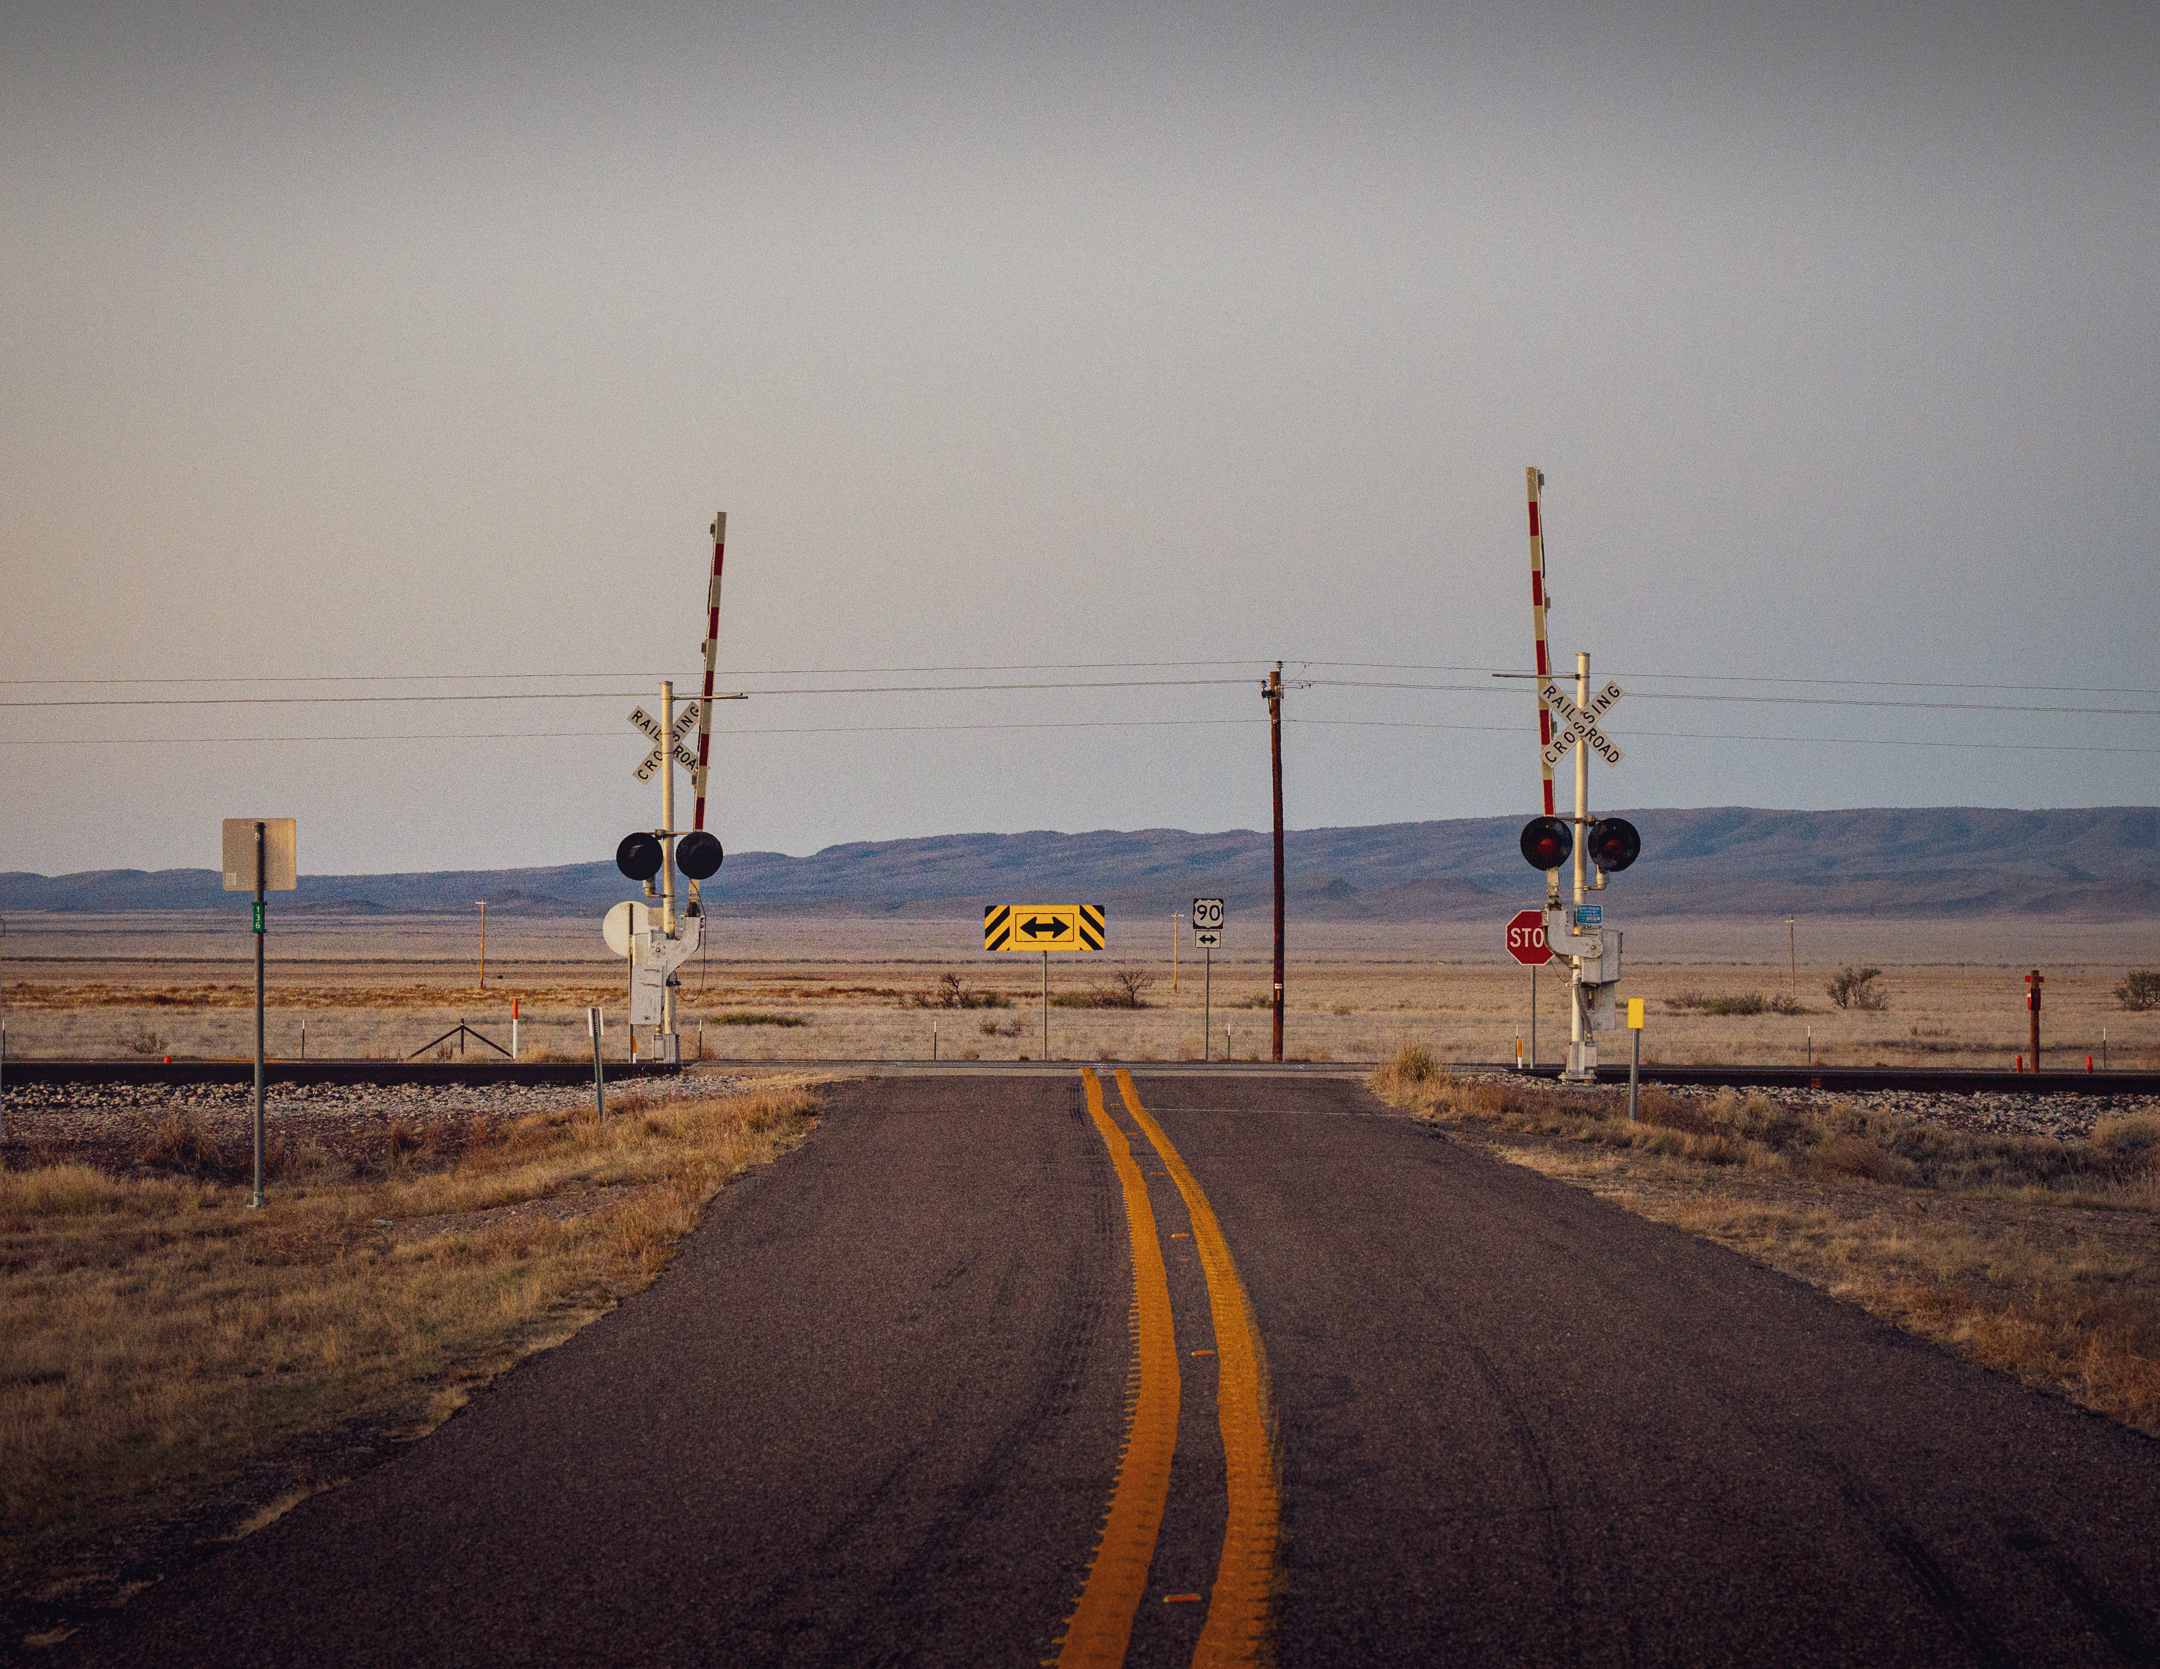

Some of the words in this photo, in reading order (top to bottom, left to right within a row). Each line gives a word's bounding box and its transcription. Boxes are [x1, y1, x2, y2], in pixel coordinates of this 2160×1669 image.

[1543, 685, 1576, 722] RAIL
[1584, 727, 1620, 763] ROAD
[1544, 685, 1620, 763] CROSSING
[673, 745, 699, 772] ROA
[1197, 904, 1220, 921] 90
[1509, 927, 1545, 948] STO
